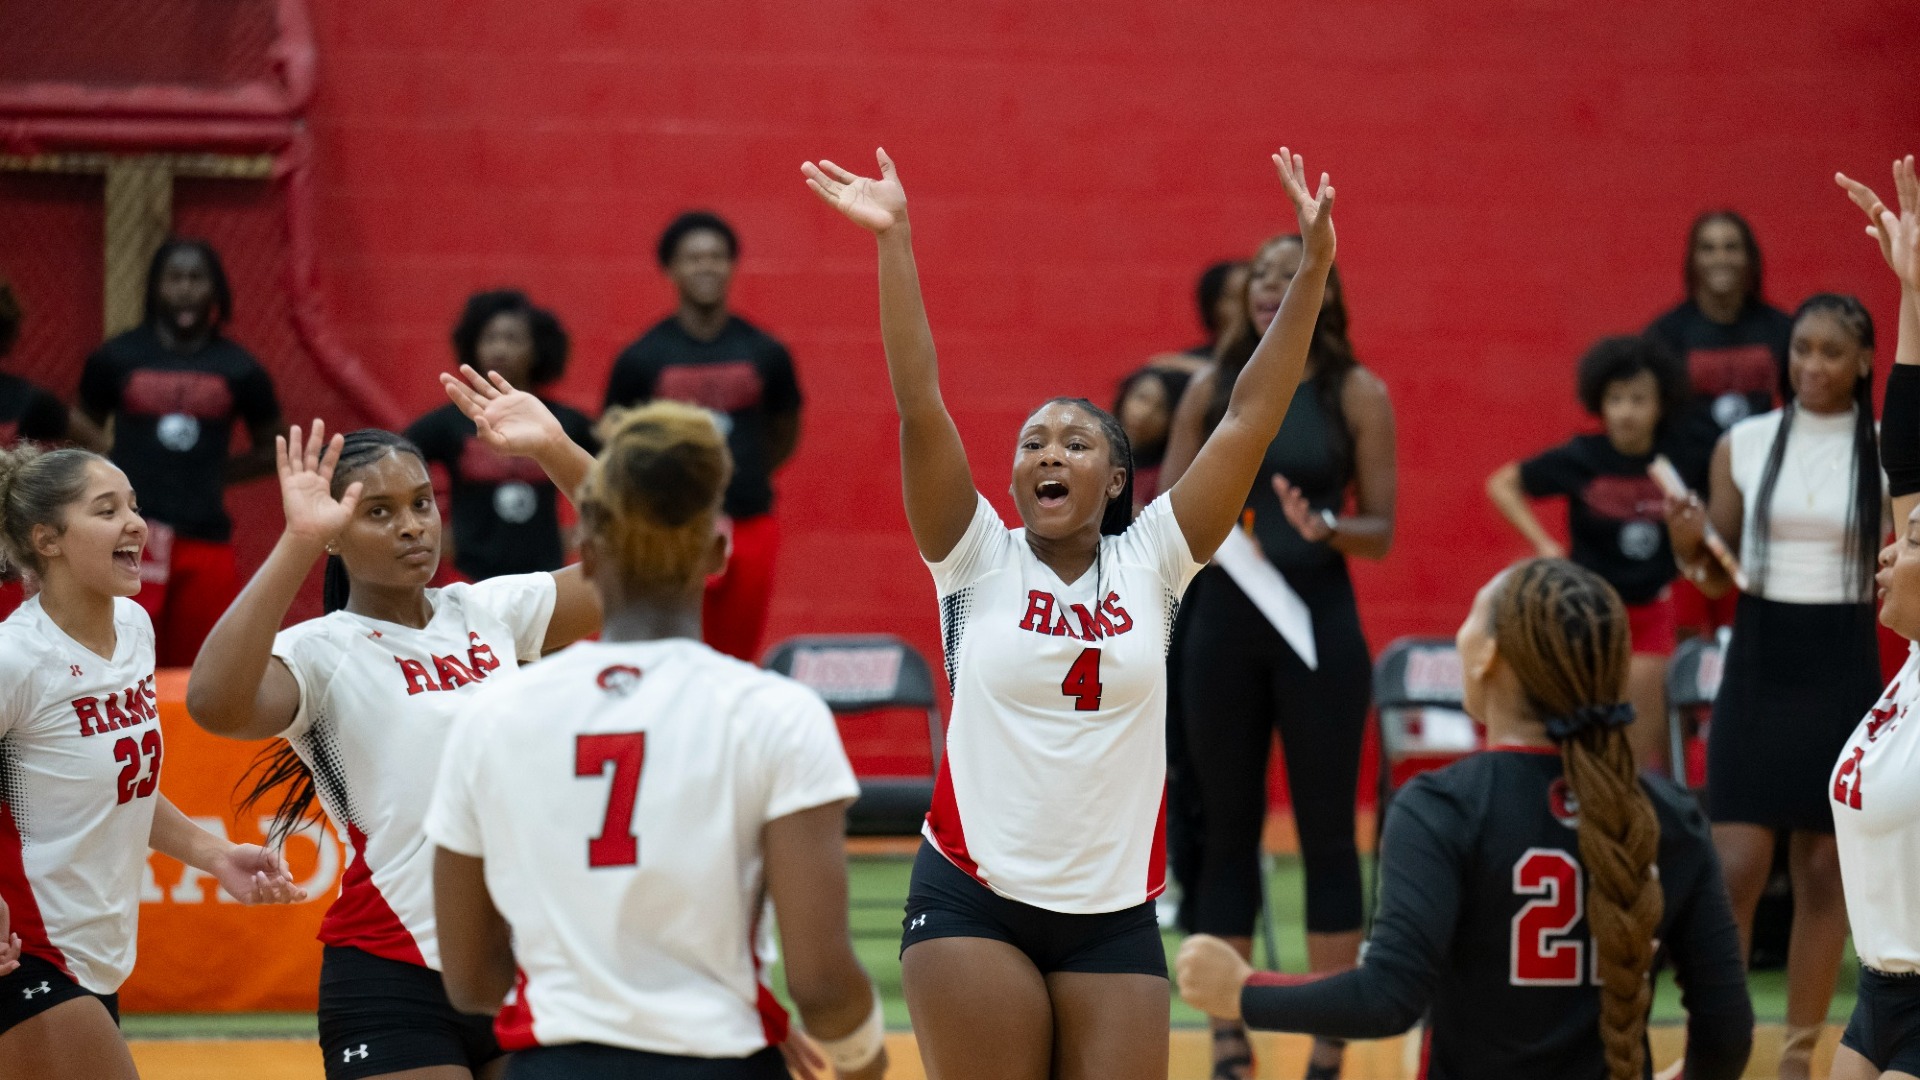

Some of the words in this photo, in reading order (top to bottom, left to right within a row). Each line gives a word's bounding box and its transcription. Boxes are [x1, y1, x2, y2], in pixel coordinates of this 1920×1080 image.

[1018, 589, 1134, 642] RAMS
[1061, 647, 1103, 711] 4
[113, 728, 163, 806] 23
[574, 730, 646, 868] 7
